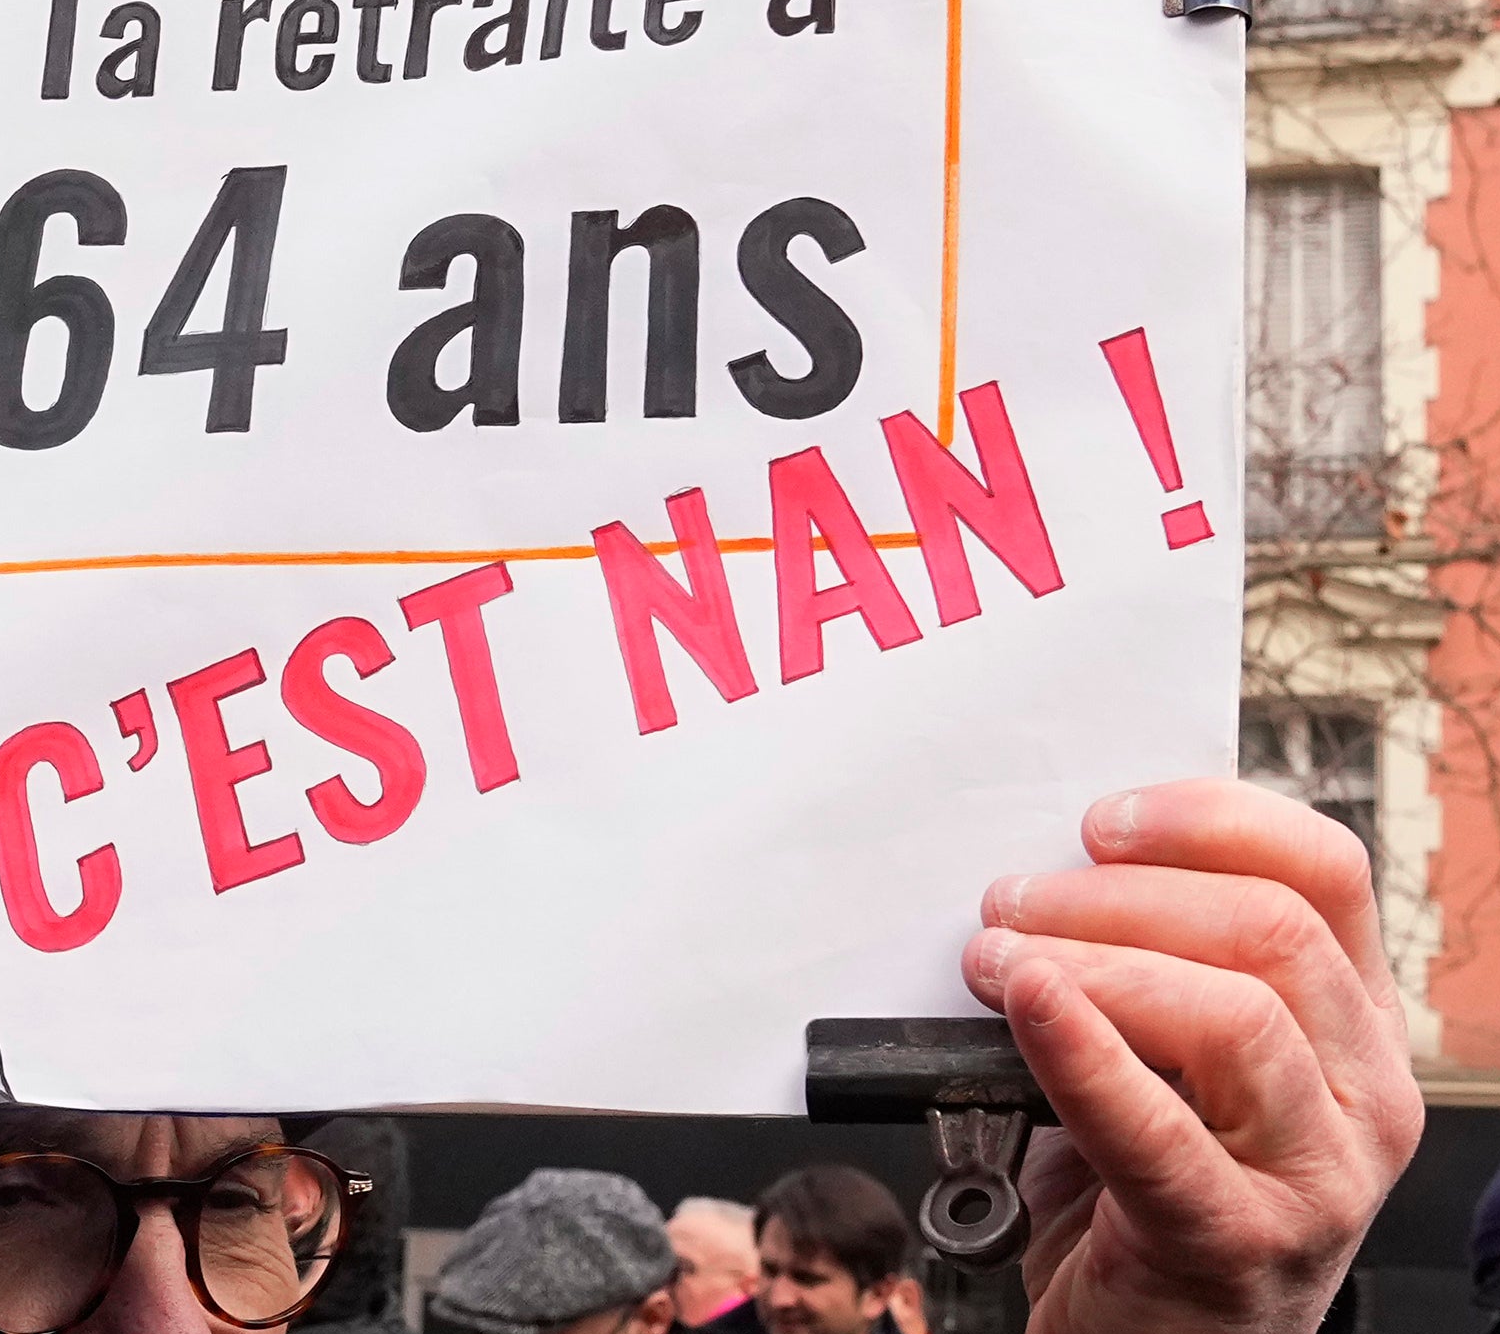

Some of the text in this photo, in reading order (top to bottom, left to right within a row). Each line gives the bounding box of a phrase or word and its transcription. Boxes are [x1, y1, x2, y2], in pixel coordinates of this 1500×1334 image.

[387, 197, 866, 428] ans
[592, 381, 1065, 735] NAN
[1099, 327, 1215, 550] !
